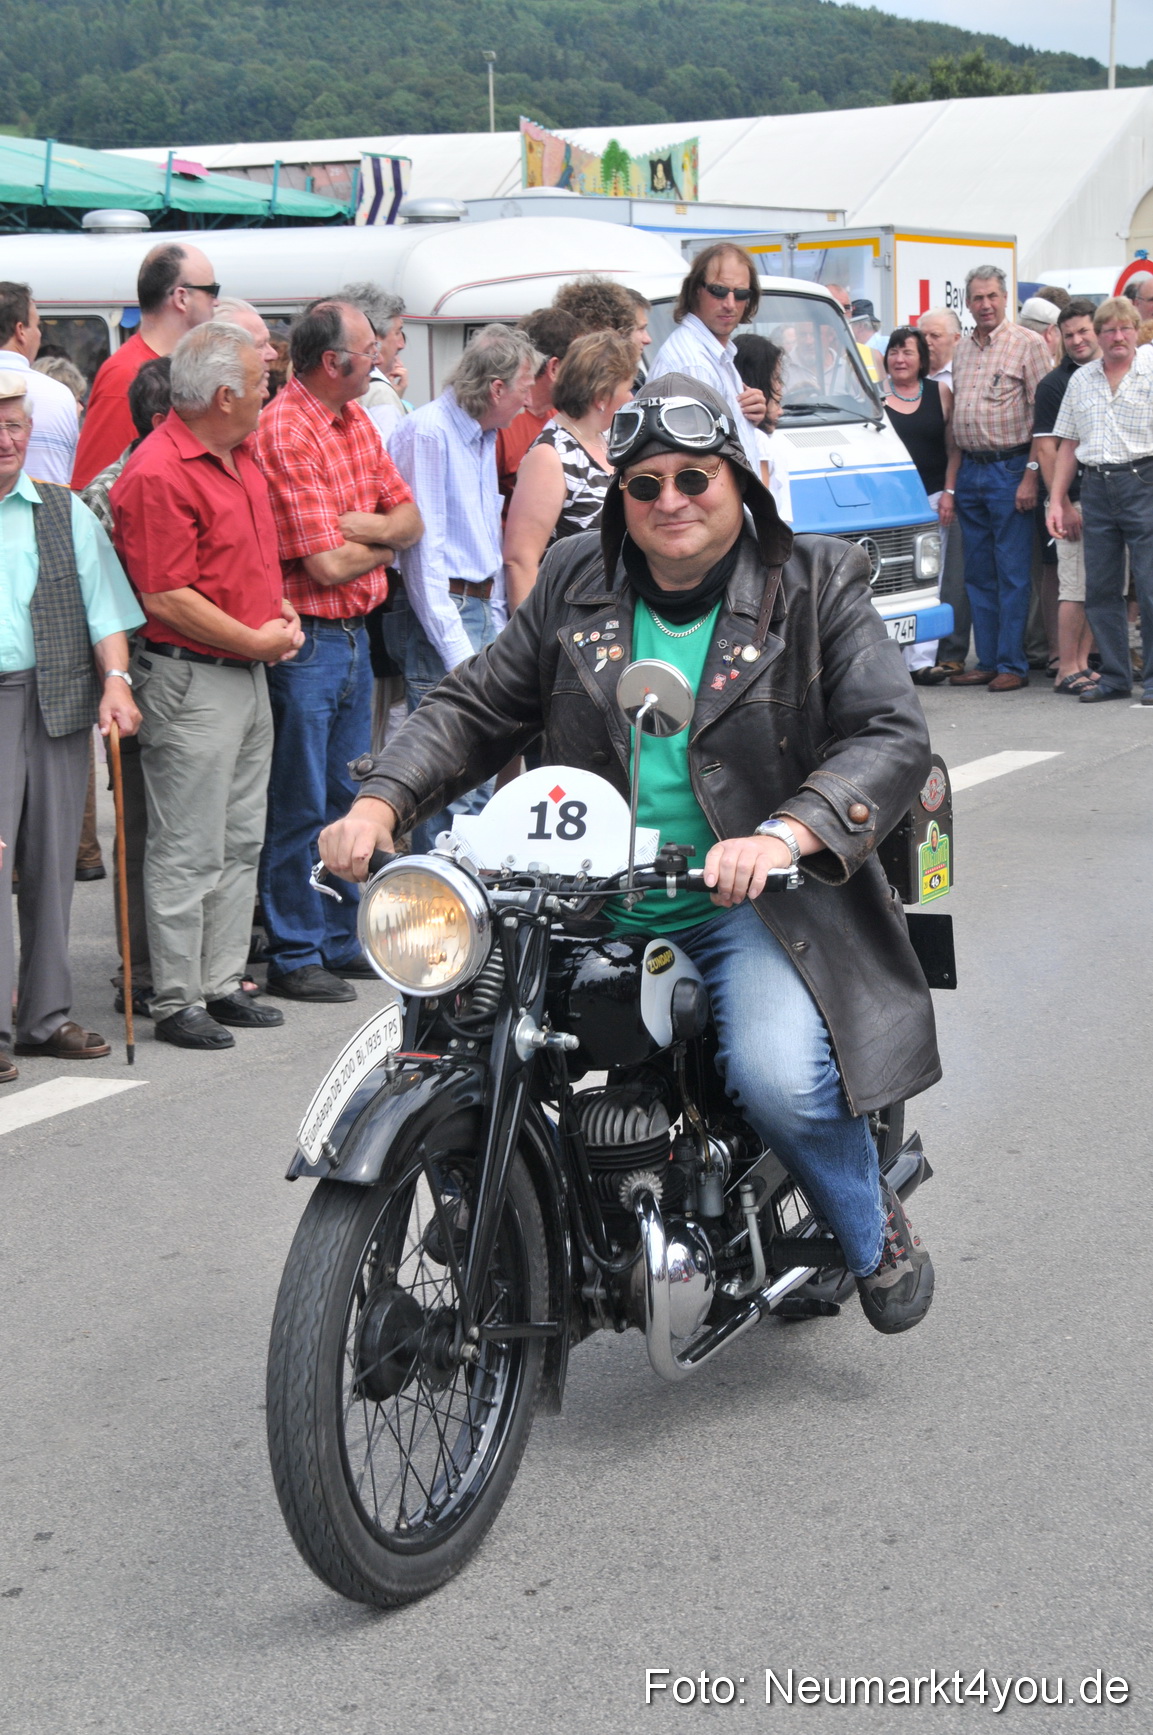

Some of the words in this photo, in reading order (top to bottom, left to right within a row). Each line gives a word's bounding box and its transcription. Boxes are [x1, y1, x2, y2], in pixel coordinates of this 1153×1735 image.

[945, 281, 965, 315] Bay
[527, 800, 588, 841] 18
[304, 1096, 333, 1151] Zündapp
[330, 1078, 342, 1101] DB
[340, 1057, 356, 1085] 200
